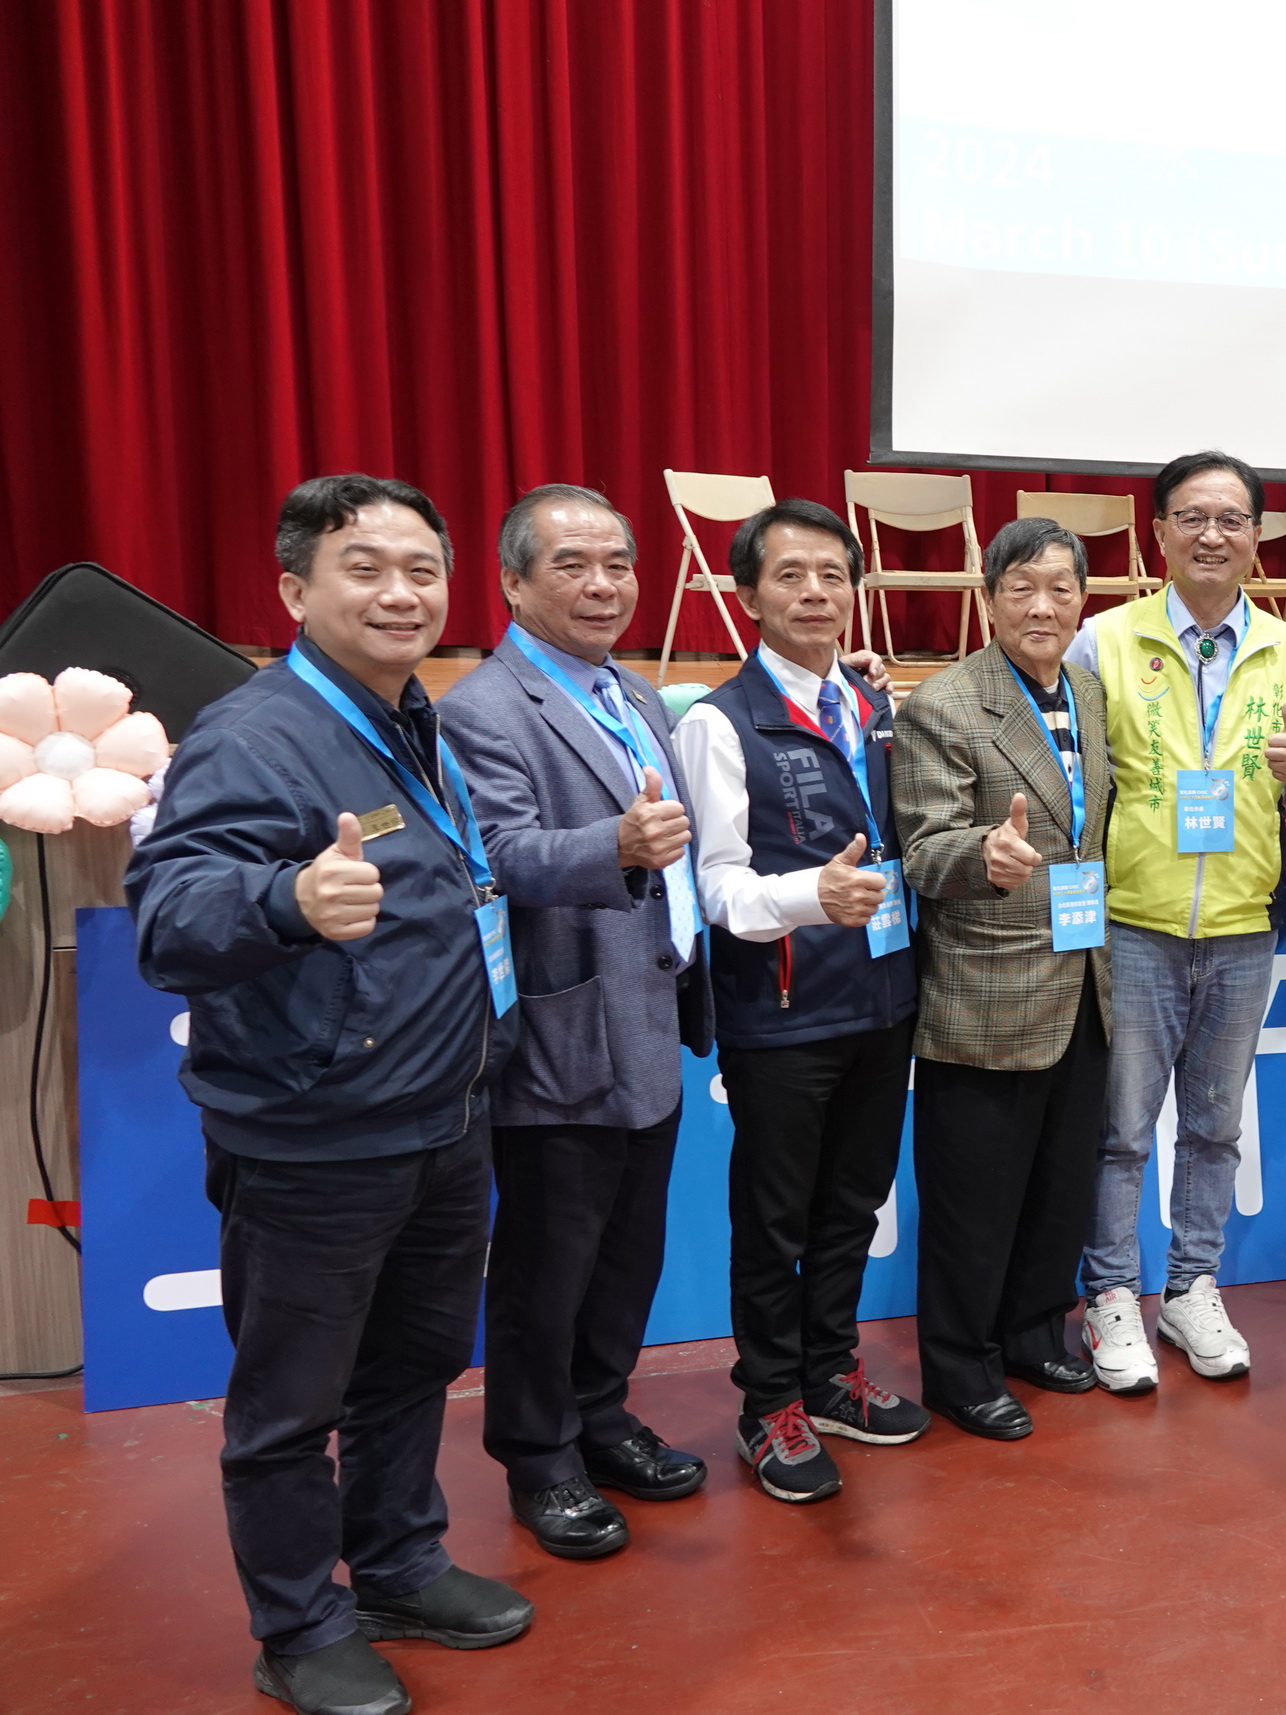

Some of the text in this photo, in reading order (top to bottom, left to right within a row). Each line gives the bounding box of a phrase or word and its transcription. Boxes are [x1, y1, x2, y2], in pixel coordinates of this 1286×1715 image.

[923, 129, 1056, 190] 2024
[924, 203, 1093, 265] March
[1111, 219, 1170, 271] 10
[1146, 701, 1164, 814] 微笑友善城市
[1241, 695, 1269, 782] 林世賢
[773, 752, 800, 811] SPORT
[786, 748, 835, 842] FILA
[1184, 815, 1226, 830] 林世賢
[1058, 909, 1097, 927] 李添津
